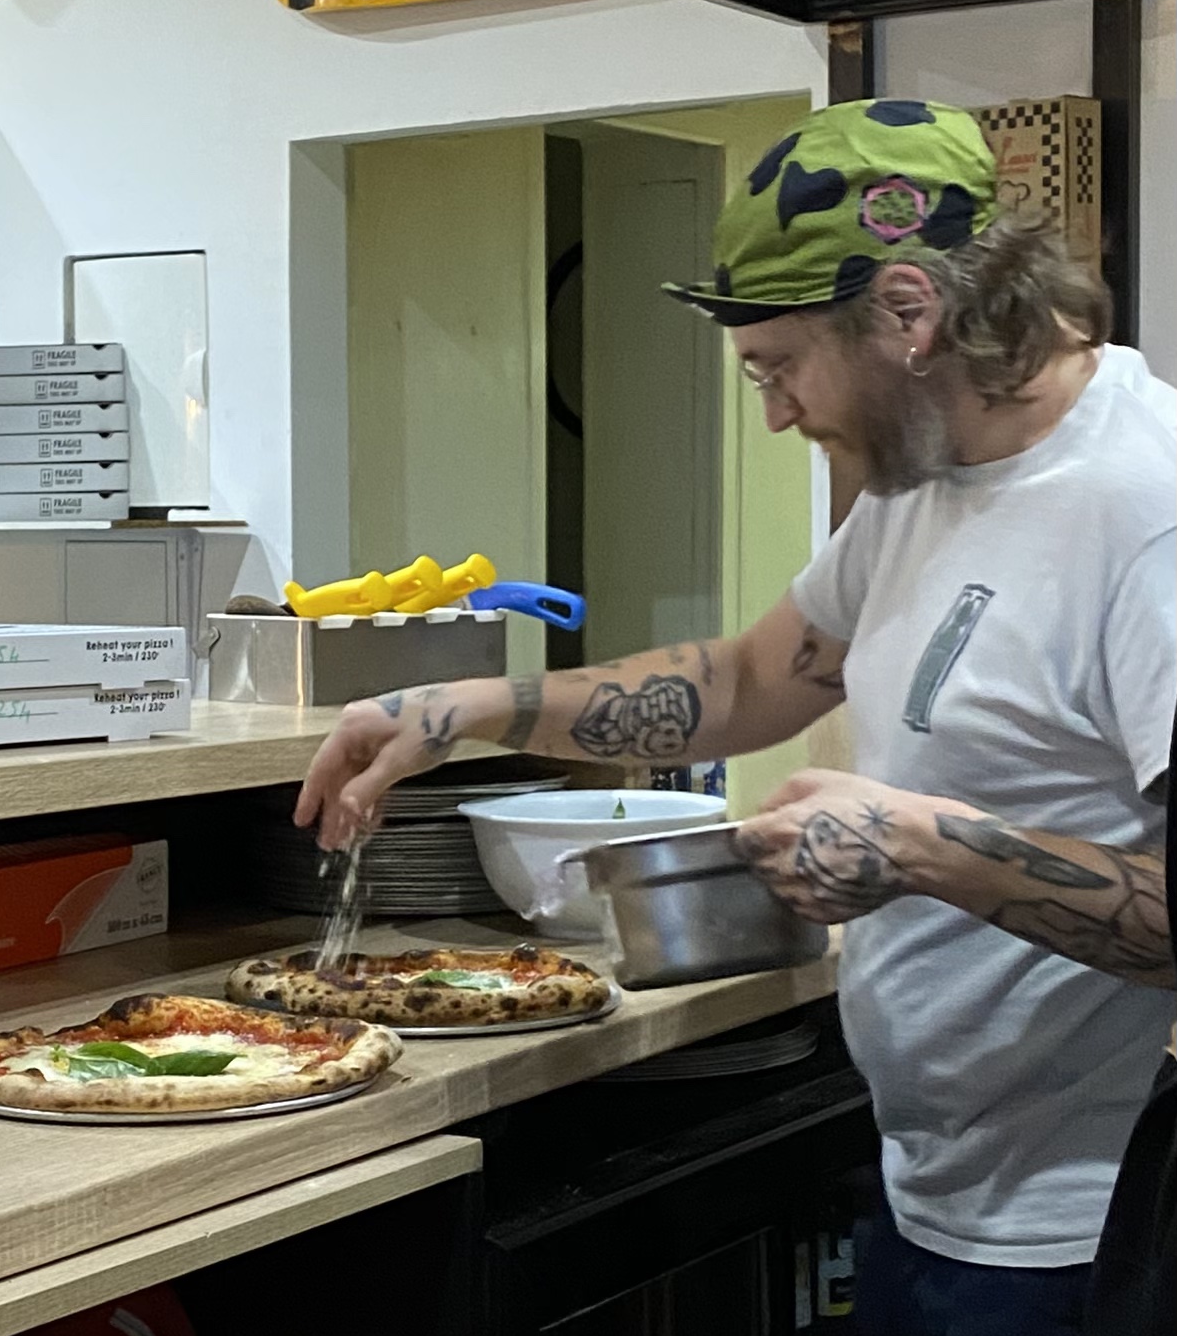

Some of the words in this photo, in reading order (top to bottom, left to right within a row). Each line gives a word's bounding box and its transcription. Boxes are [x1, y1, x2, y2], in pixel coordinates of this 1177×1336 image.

[86, 641, 118, 651] Reheat
[121, 642, 142, 652] your
[144, 639, 168, 650] pizza
[94, 692, 126, 702] Reheat
[128, 692, 149, 703] your
[151, 691, 175, 701] pizza
